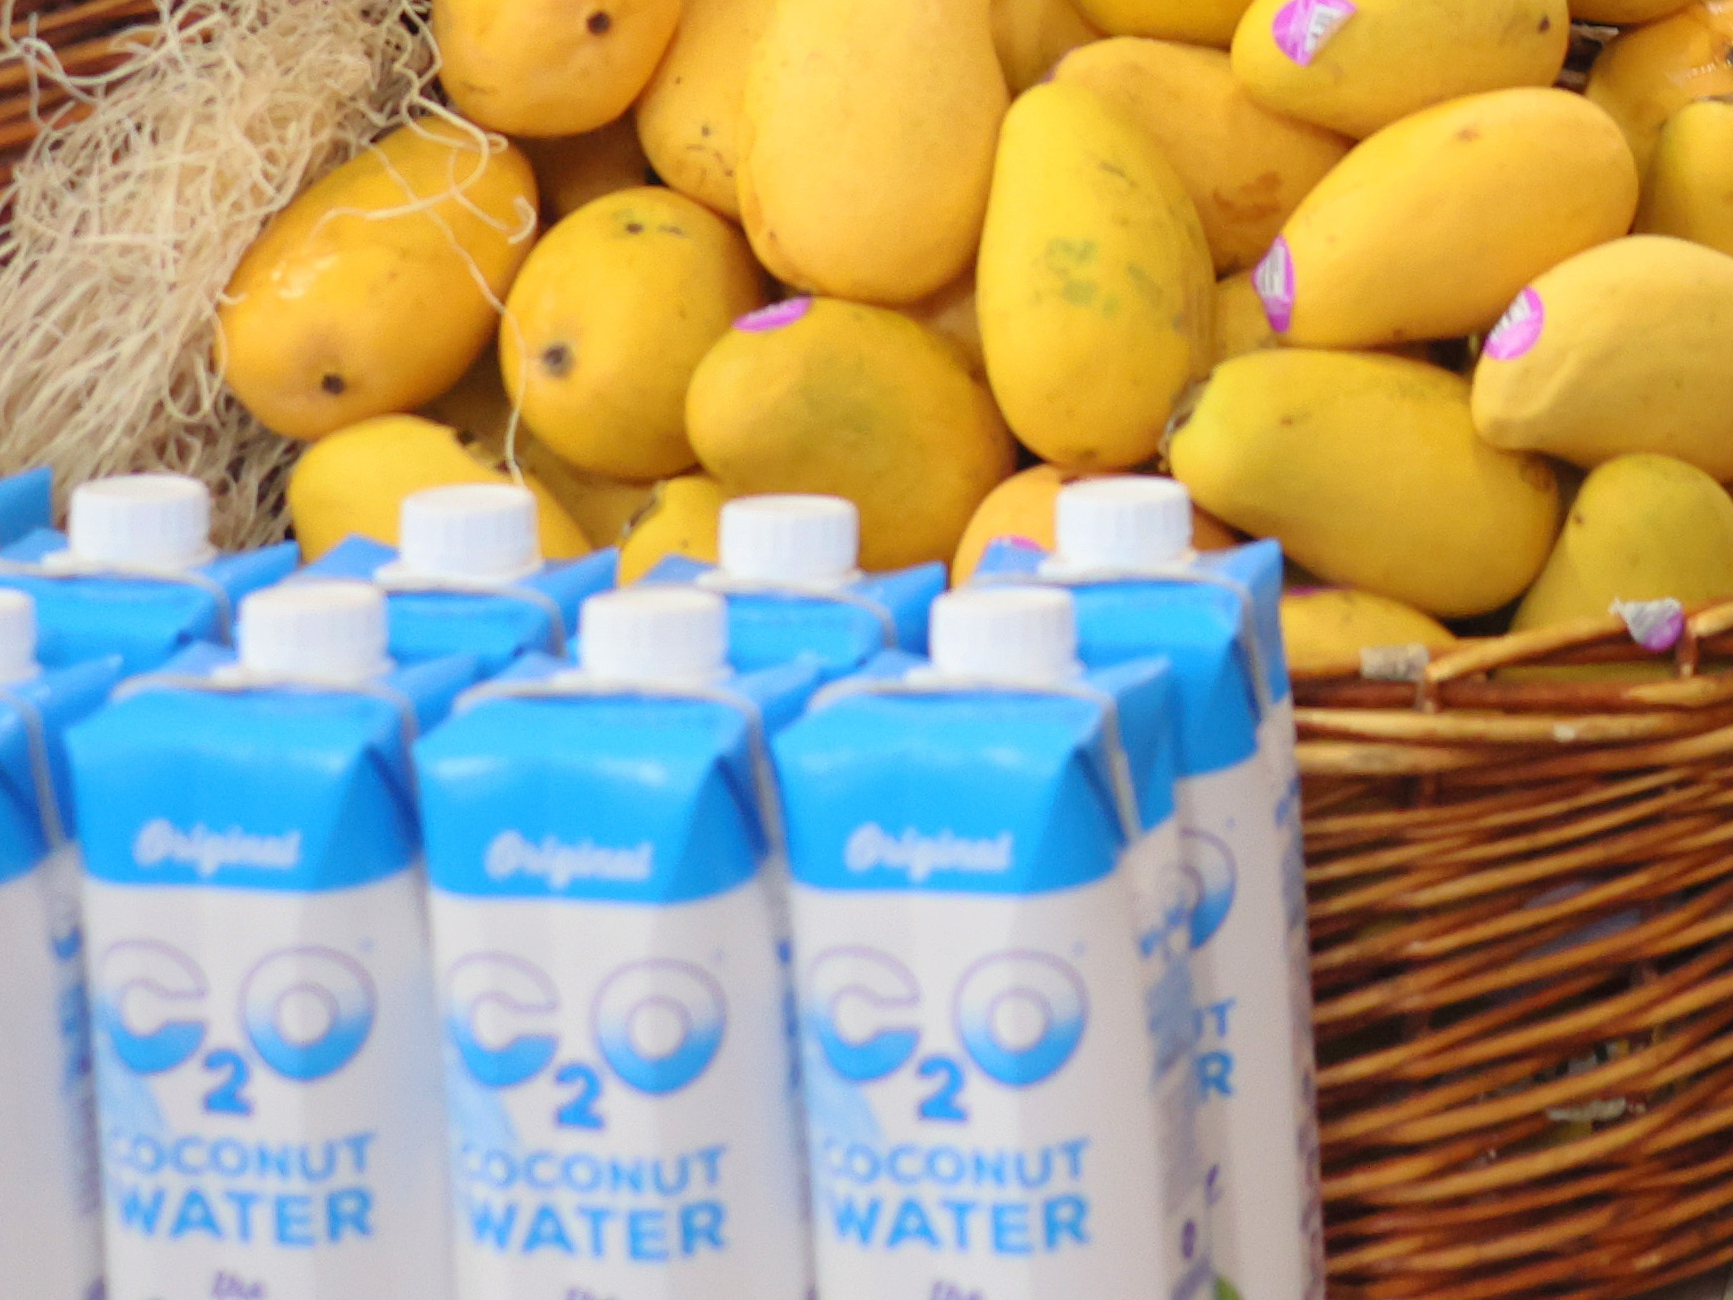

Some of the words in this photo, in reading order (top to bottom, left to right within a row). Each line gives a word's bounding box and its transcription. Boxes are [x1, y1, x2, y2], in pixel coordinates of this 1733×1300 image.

[121, 1187, 374, 1247] WATER
[469, 1201, 725, 1263] WATER
[831, 1193, 1091, 1255] WATER
